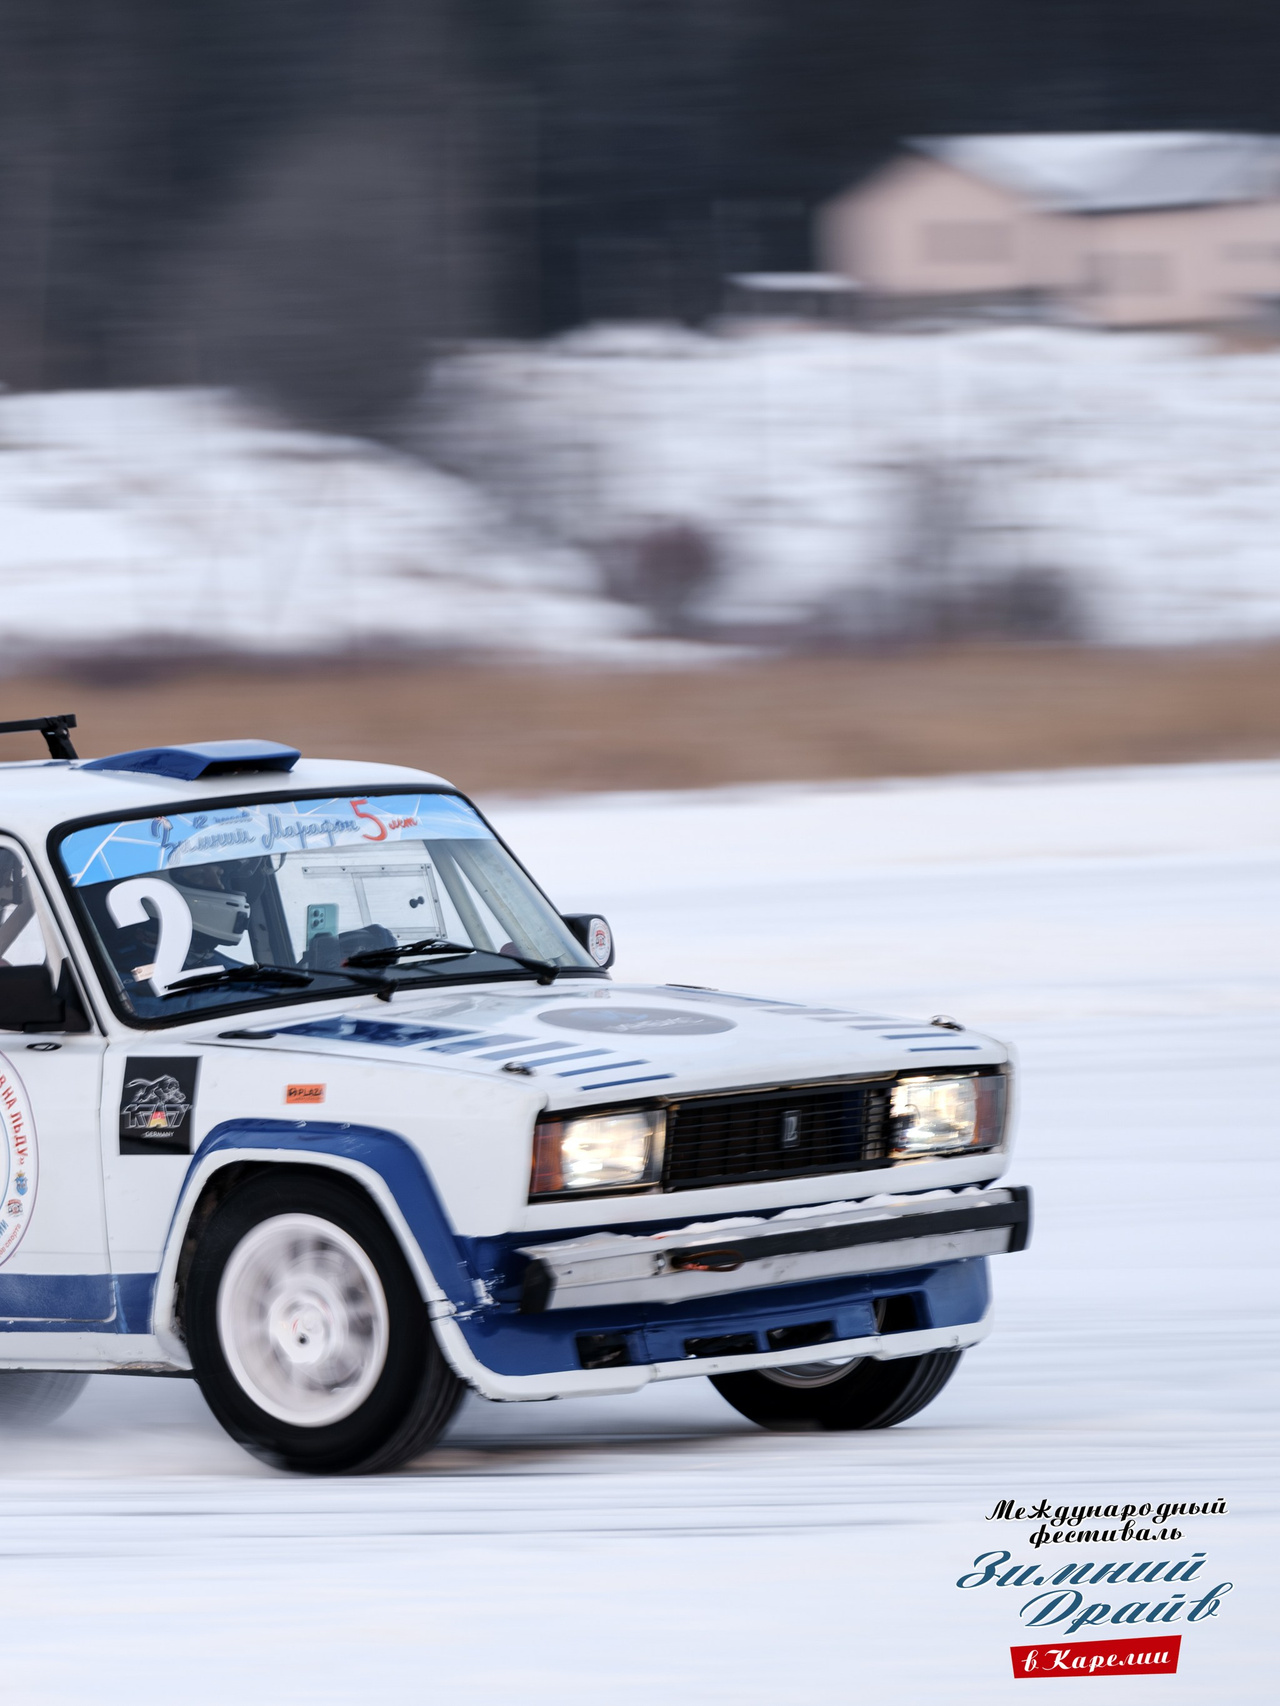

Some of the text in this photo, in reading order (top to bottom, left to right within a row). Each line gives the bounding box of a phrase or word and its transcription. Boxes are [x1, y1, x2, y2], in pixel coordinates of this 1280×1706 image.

[261, 812, 361, 850] Марафон
[349, 799, 388, 842] 5
[105, 877, 226, 998] 2
[2, 1087, 18, 1110] НА
